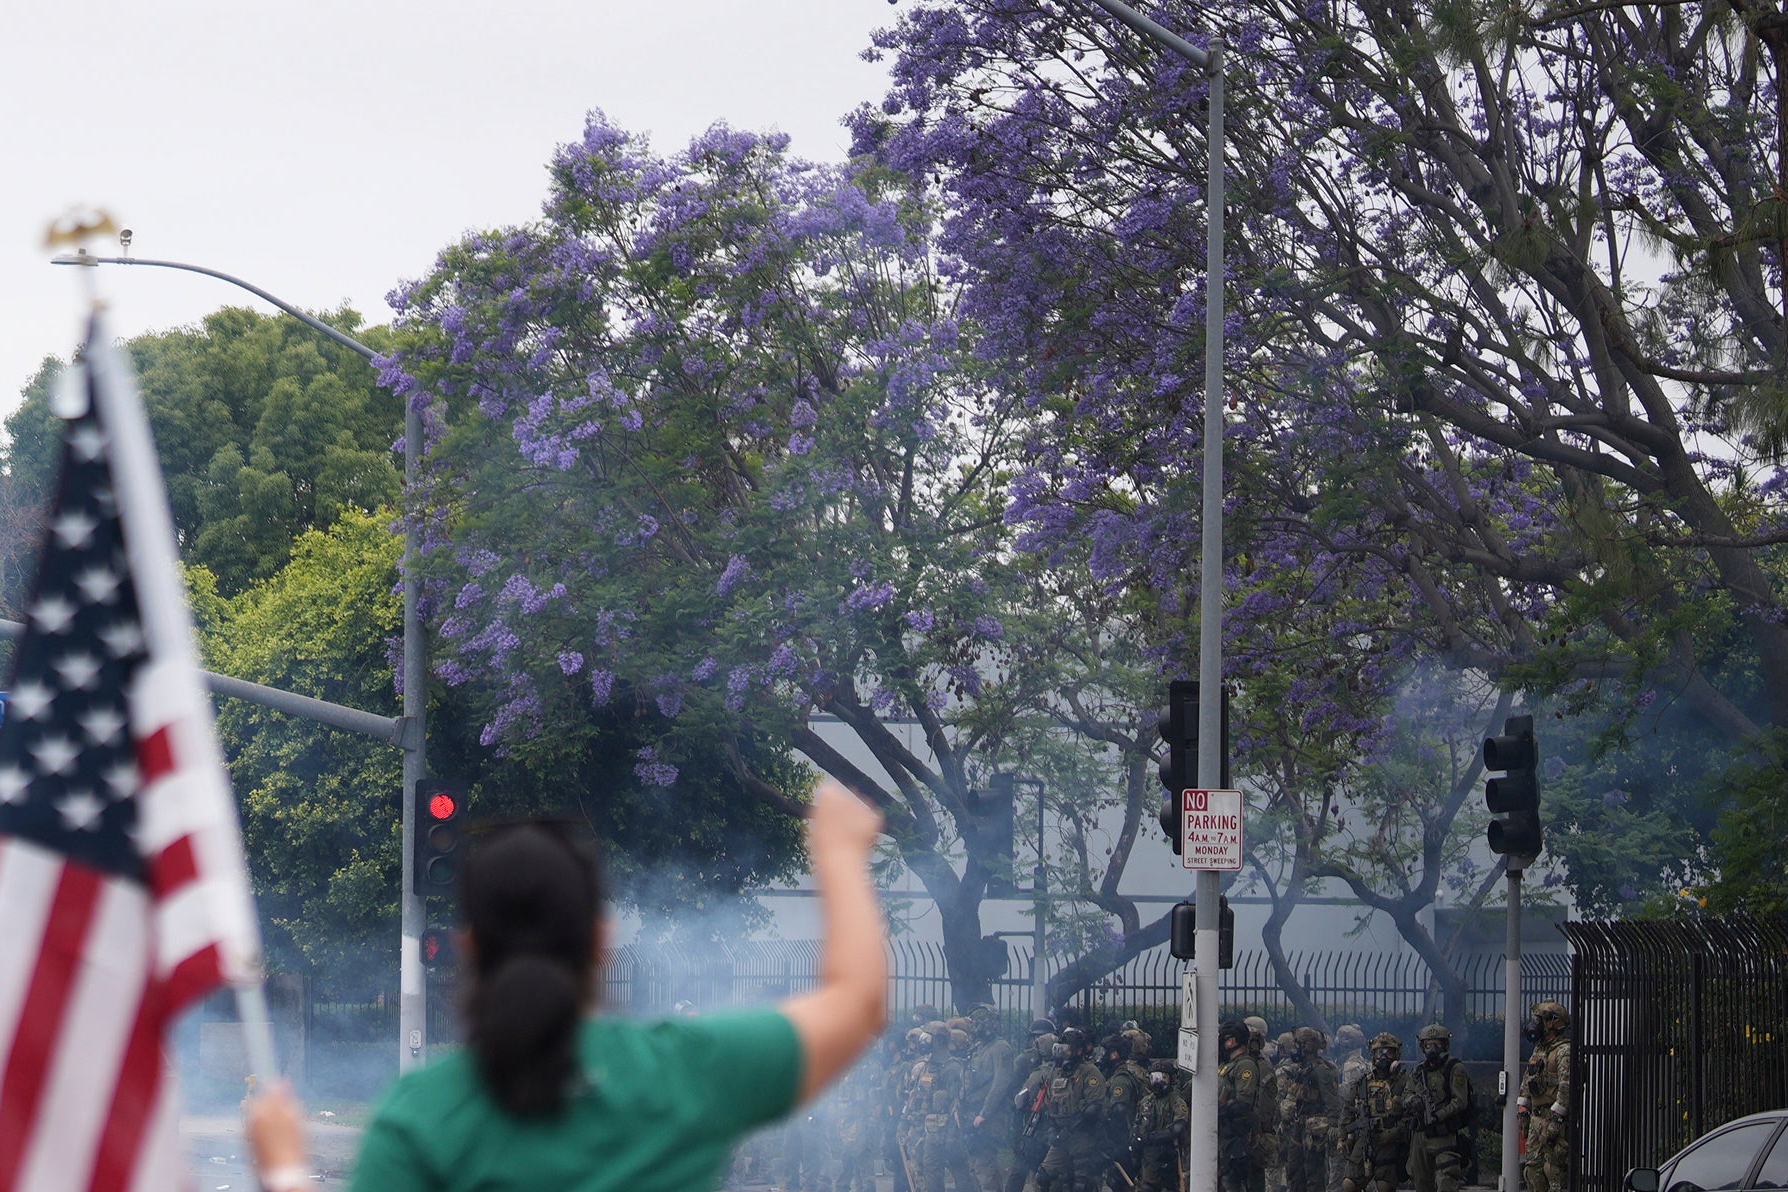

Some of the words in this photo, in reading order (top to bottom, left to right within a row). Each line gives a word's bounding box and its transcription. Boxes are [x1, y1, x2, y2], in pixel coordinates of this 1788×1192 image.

[1186, 792, 1205, 810] NO
[1187, 815, 1237, 830] PARKING
[1195, 846, 1229, 855] MONDAY
